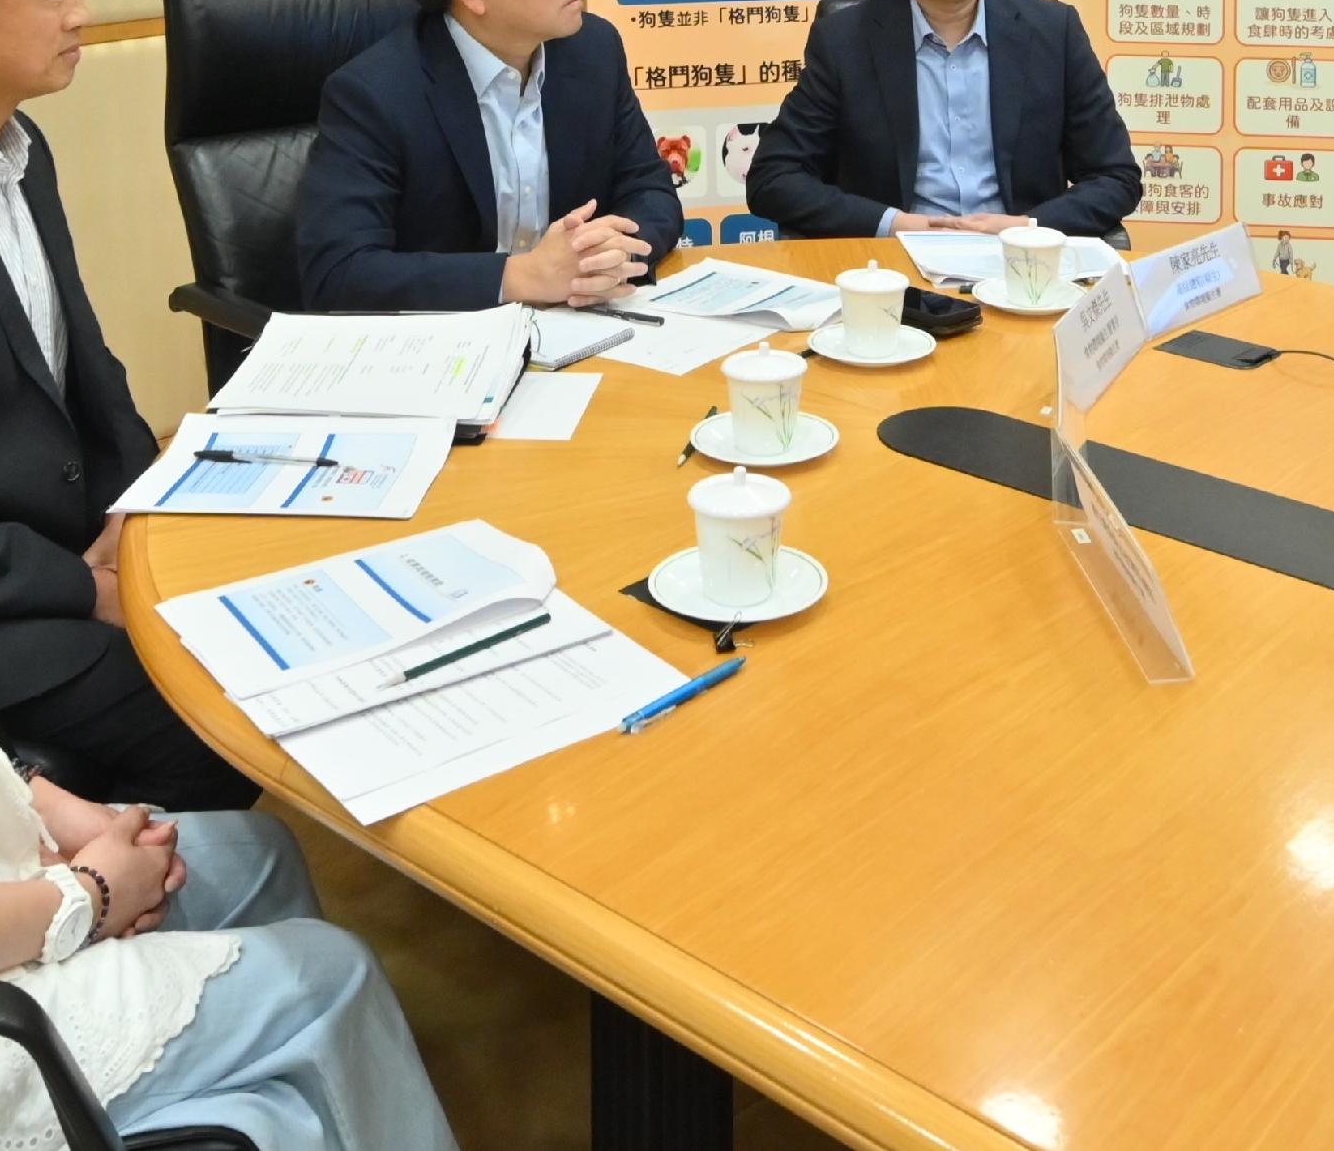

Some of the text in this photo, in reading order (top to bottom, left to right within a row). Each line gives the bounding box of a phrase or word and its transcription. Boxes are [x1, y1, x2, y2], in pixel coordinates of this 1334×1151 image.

[1255, 7, 1333, 23] 讓狗隻進入
[1118, 21, 1211, 37] 段及區域規劃
[1118, 92, 1211, 109] 狗隻排泄物處
[1156, 110, 1171, 125] 理
[1286, 114, 1300, 130] 備
[1135, 200, 1201, 216] 障與安排
[1262, 192, 1324, 210] 事故應對
